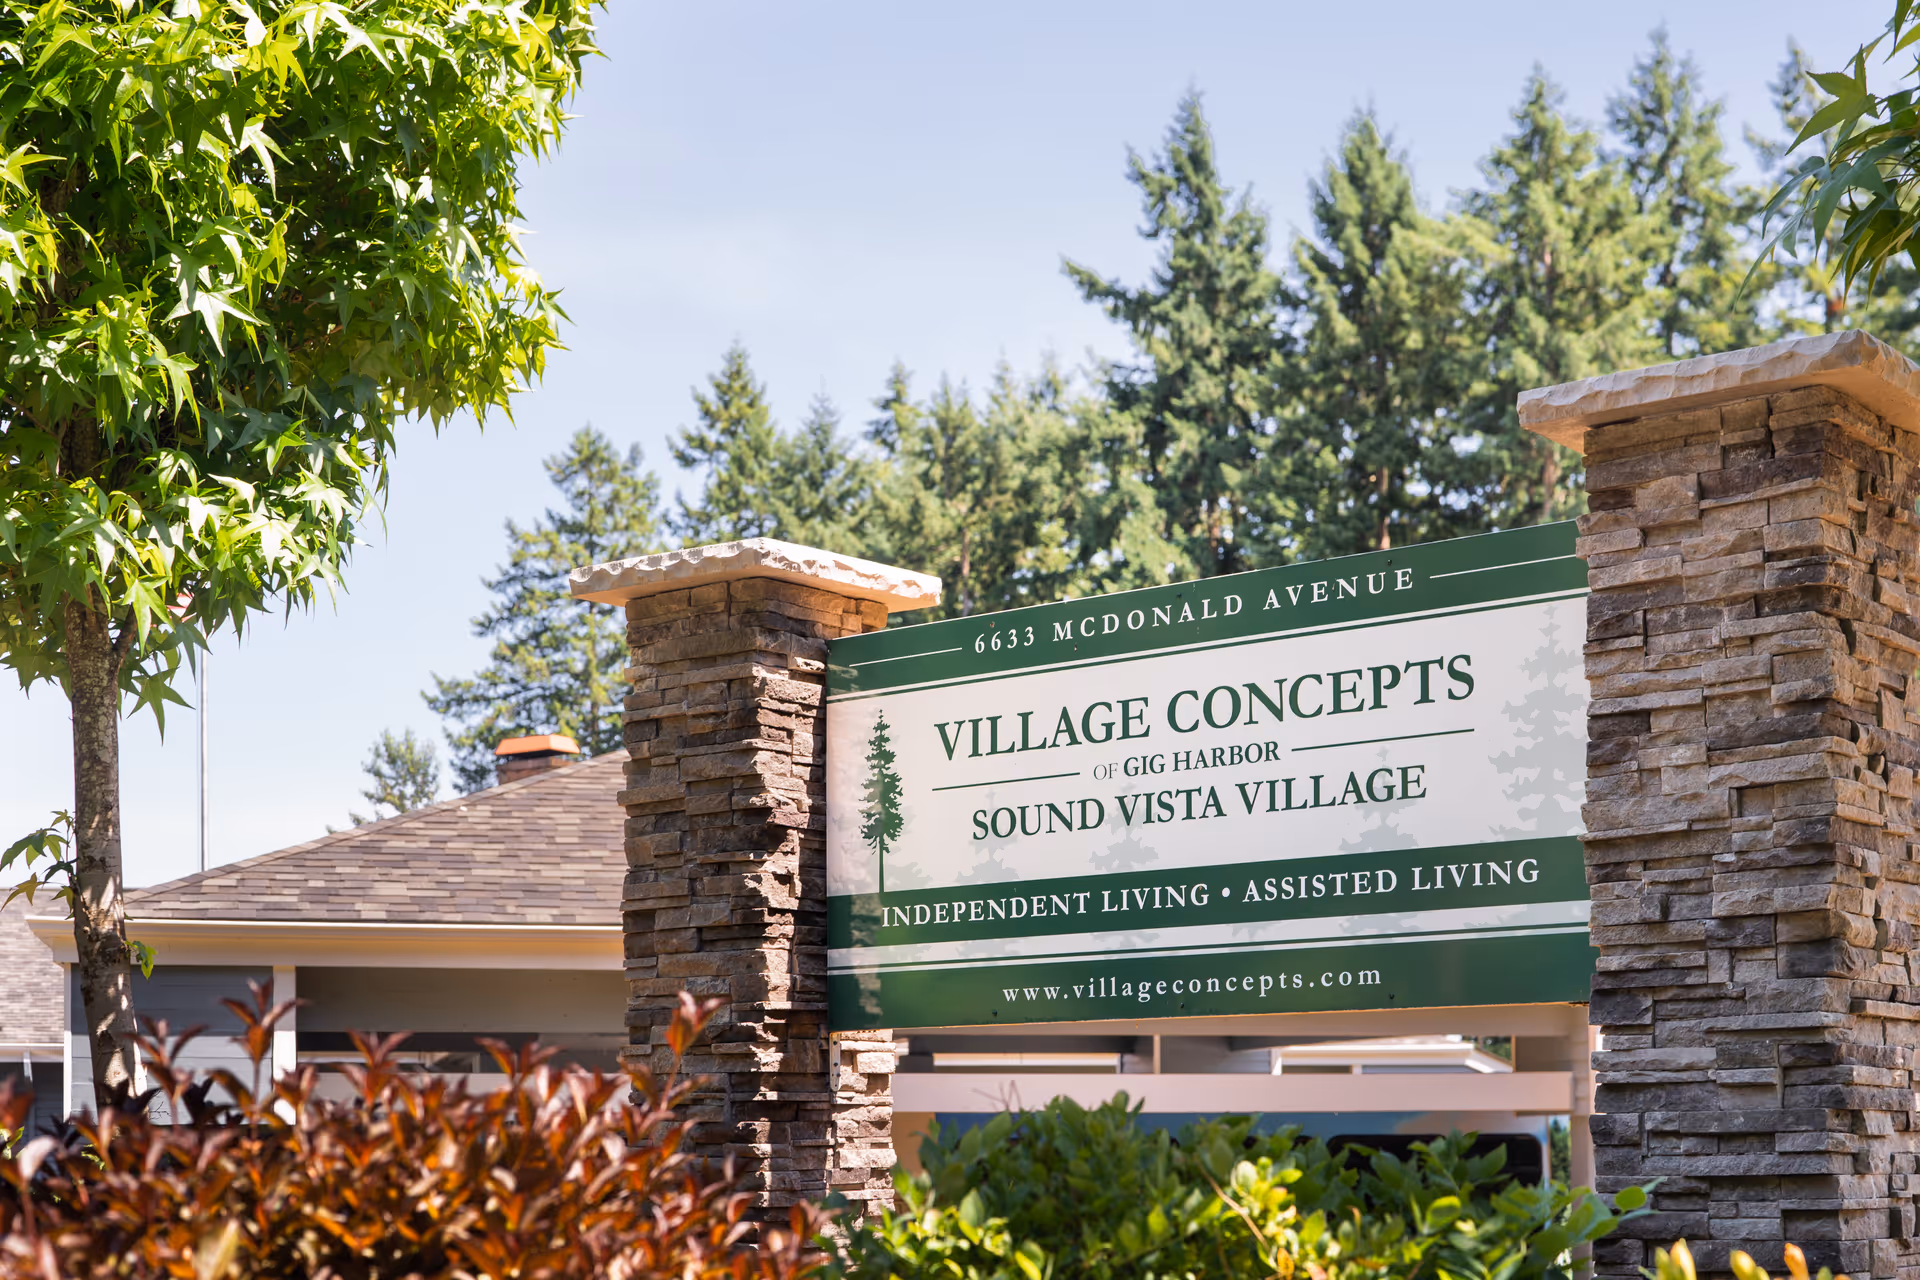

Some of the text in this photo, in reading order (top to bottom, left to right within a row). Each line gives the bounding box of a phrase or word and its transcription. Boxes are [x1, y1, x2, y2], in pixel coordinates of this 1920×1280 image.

[974, 568, 1414, 654] 6633 MCDONALD AVENUE
[934, 654, 1475, 761] VILLAGE CONCEPTS
[1093, 741, 1281, 781] OF GIG HARBOR
[972, 765, 1428, 840] SOUND VISTA VILLAGE
[881, 858, 1540, 928] INDEPENDENT LIVING ASSISTED LIVING
[1002, 968, 1382, 1003] www.villageconcepts.com
